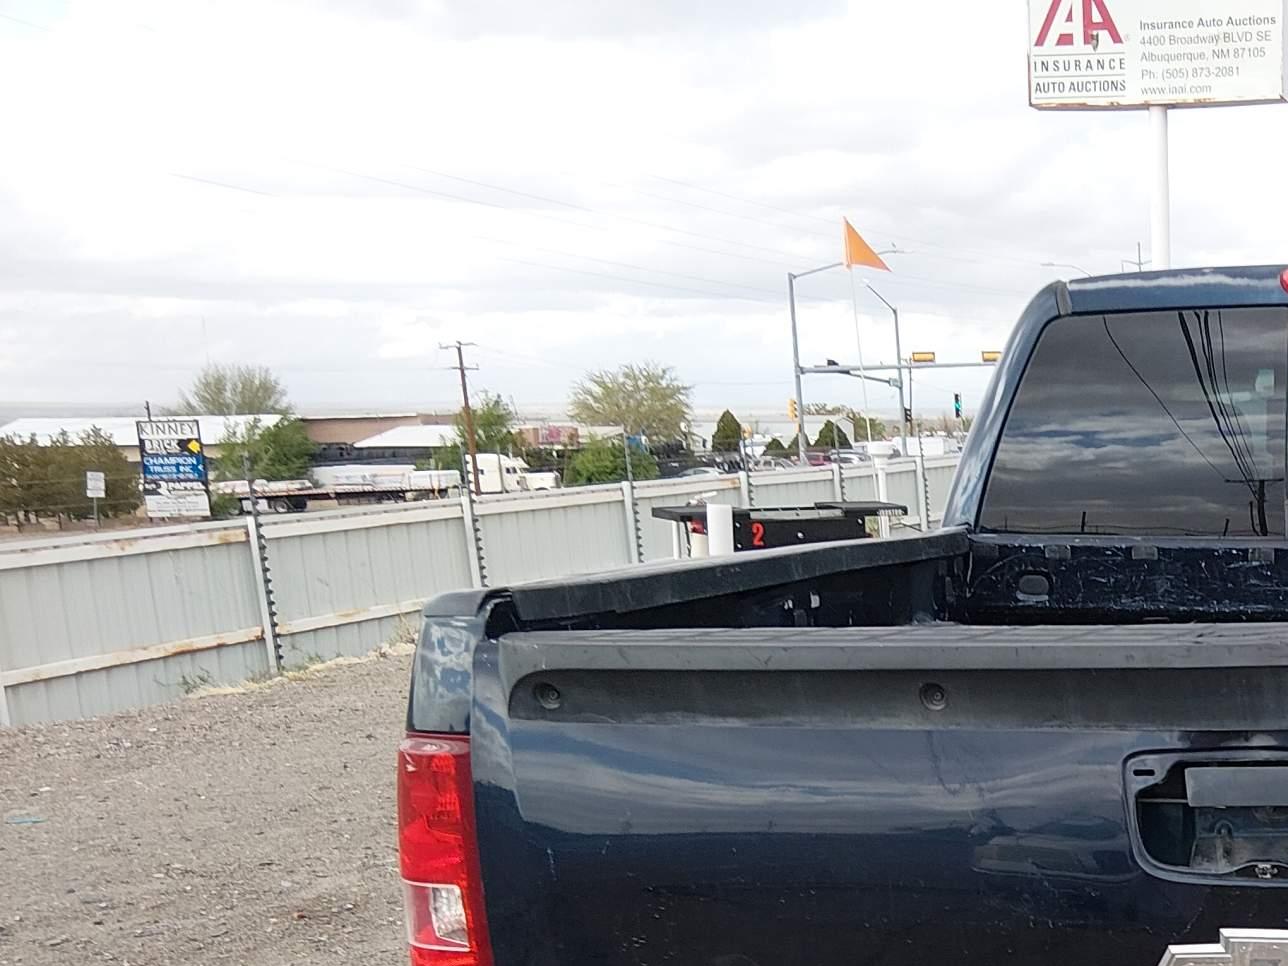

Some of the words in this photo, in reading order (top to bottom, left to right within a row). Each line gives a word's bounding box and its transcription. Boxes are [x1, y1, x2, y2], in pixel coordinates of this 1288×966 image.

[1140, 19, 1194, 31] Insurance
[1197, 17, 1223, 28] Auto
[1226, 15, 1276, 27] Auctions
[1140, 35, 1166, 46] 4400
[1169, 32, 1220, 46] Broadway
[1223, 32, 1253, 43] BLVD
[1256, 30, 1272, 42] SE
[1140, 50, 1209, 63] Albuquerque,
[1212, 48, 1230, 60] NM
[1233, 47, 1266, 59] 87105
[1033, 58, 1126, 73] INSURANCE
[1161, 67, 1189, 81] (505)
[1192, 66, 1240, 78] 873-2081
[1035, 81, 1065, 94] AUTO
[1069, 79, 1126, 93] AUCTIONS
[1140, 84, 1212, 96] www.iaai.com
[139, 422, 195, 436] KINNEY
[144, 439, 179, 452] BRICK
[143, 456, 197, 465] CHAMPION
[751, 523, 765, 546] 2
